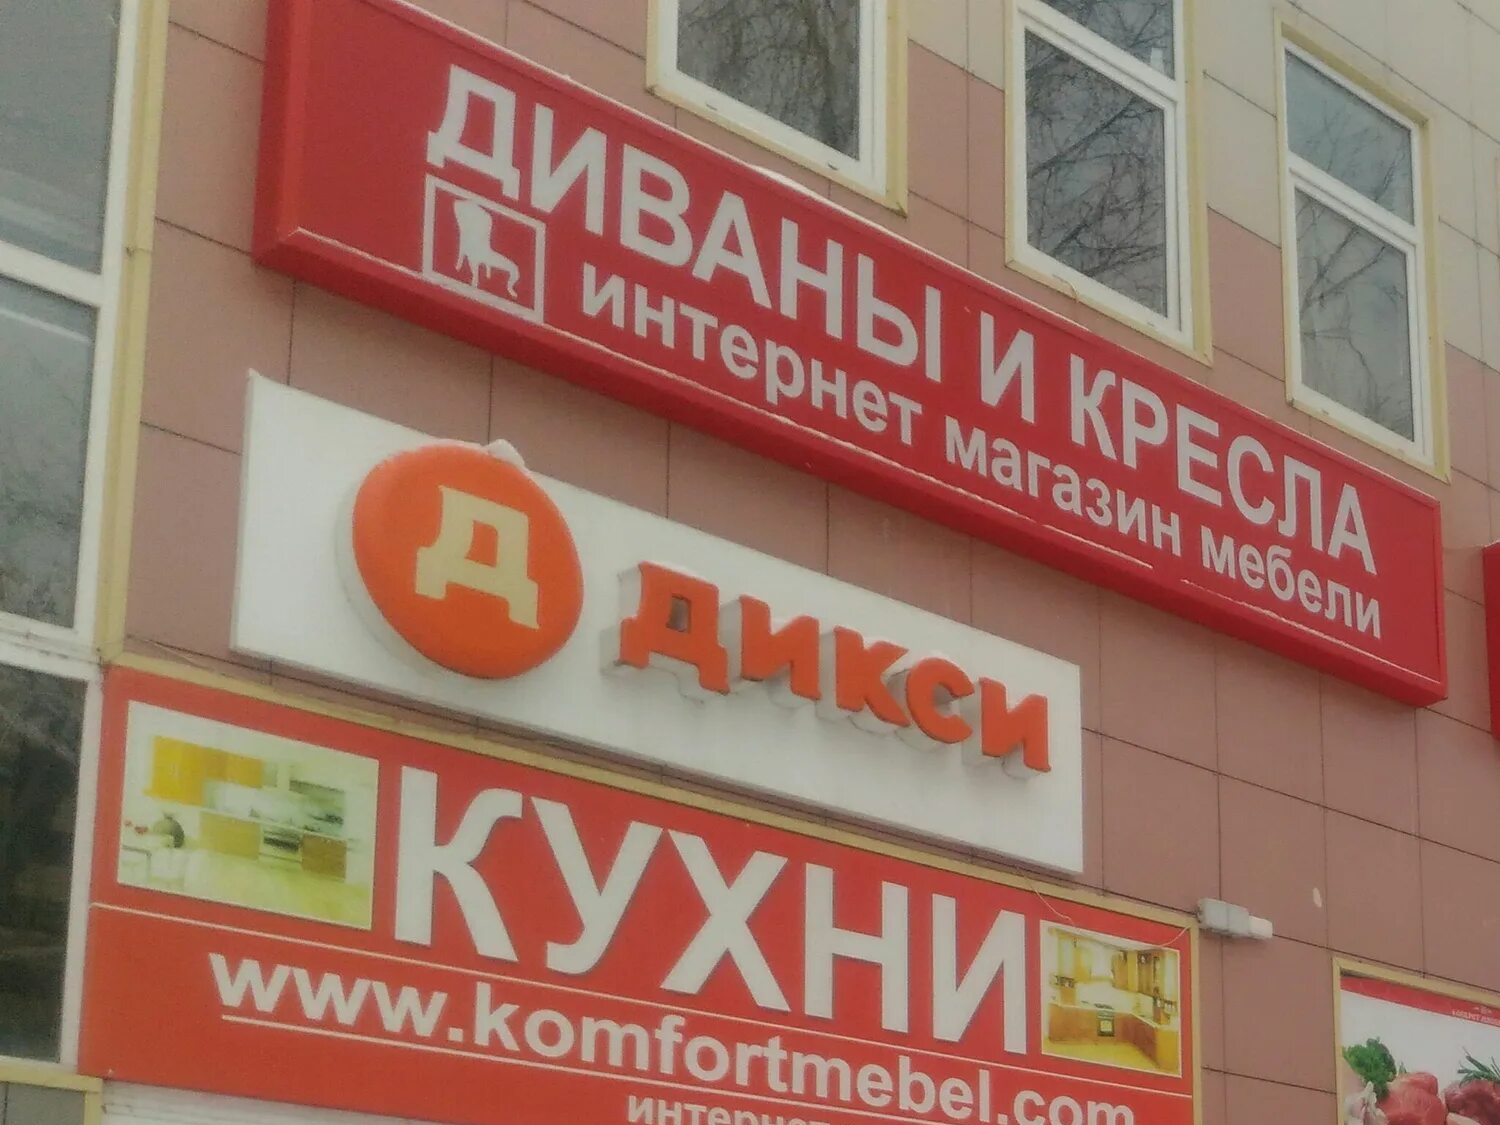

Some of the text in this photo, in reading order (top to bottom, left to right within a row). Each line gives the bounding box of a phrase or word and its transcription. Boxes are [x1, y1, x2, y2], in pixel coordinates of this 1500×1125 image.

[426, 64, 1377, 574] ДИВАНЫ И КРЕСЛА
[583, 261, 1381, 639] интернет магазин мебели
[415, 484, 539, 629] Д
[619, 561, 1051, 773] ДИКСИ
[394, 765, 1027, 1055] КУХНИ
